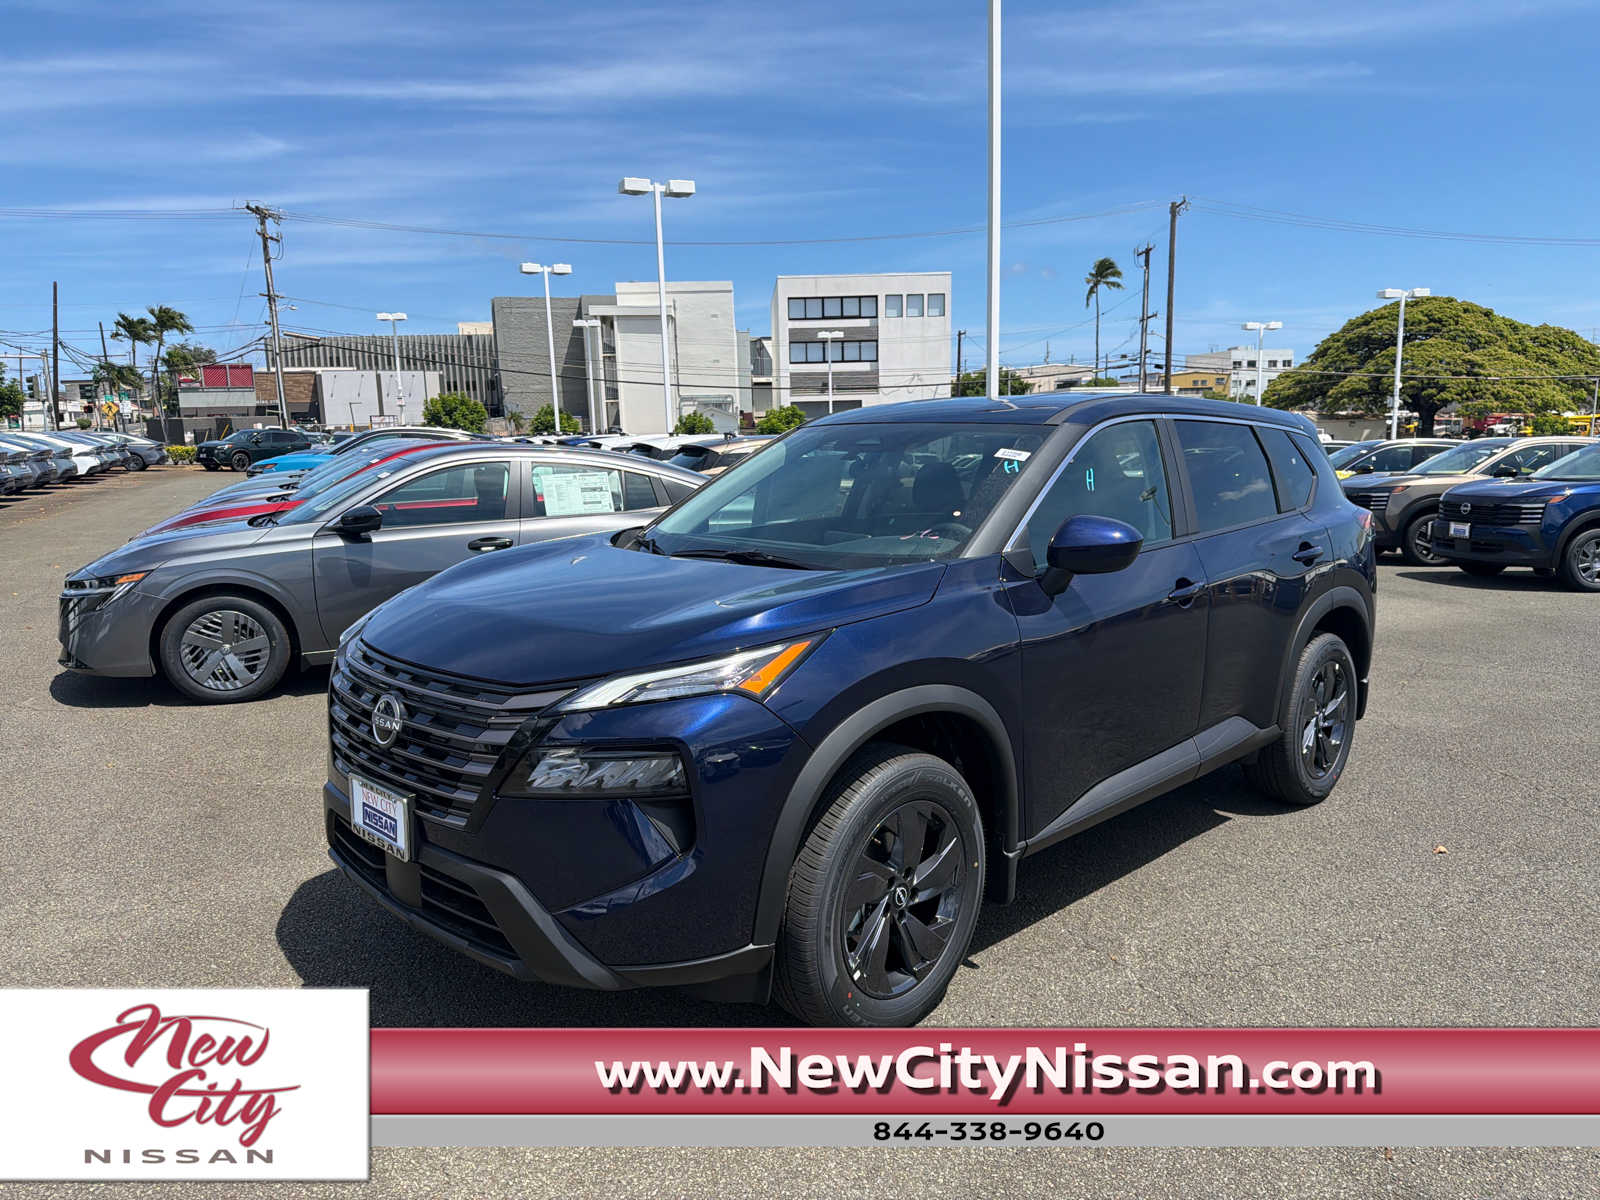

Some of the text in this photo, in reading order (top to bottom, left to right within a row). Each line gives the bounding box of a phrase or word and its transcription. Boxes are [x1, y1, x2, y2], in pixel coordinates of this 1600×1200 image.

[1086, 468, 1095, 491] H
[362, 788, 378, 806] NEW
[380, 798, 397, 816] CITY
[364, 807, 396, 838] NISSAN
[352, 823, 405, 859] NISSAN
